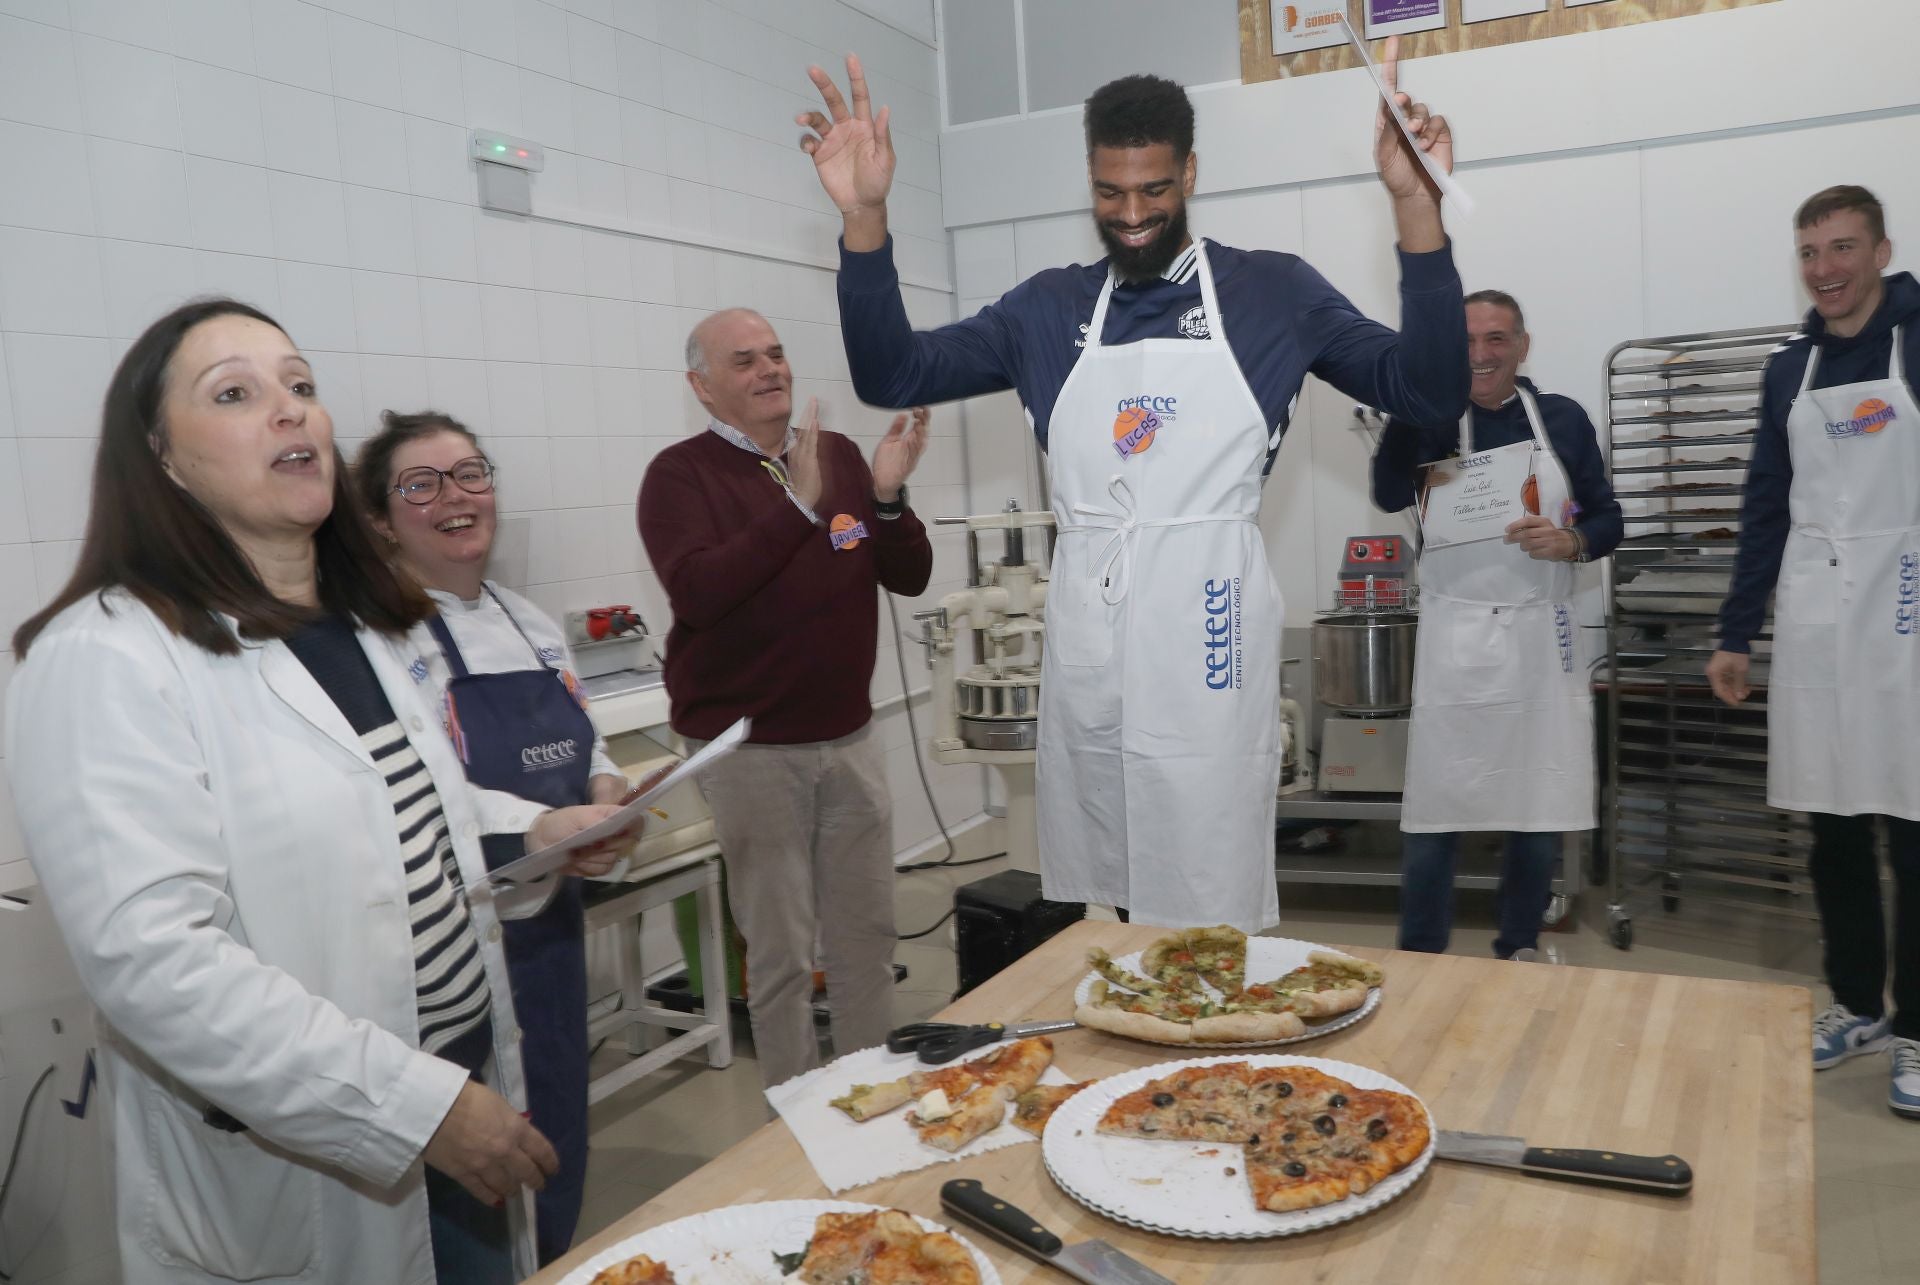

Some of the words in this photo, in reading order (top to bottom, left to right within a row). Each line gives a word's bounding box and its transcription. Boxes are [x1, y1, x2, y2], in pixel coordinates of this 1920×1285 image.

[1181, 318, 1207, 331] PALEN
[1115, 412, 1159, 456] LUCAS
[834, 524, 863, 547] JAVIER
[1233, 577, 1242, 647] TECNOLÓGICO
[1895, 554, 1914, 635] cetece
[1204, 579, 1230, 690] cetece
[521, 738, 576, 765] cetece
